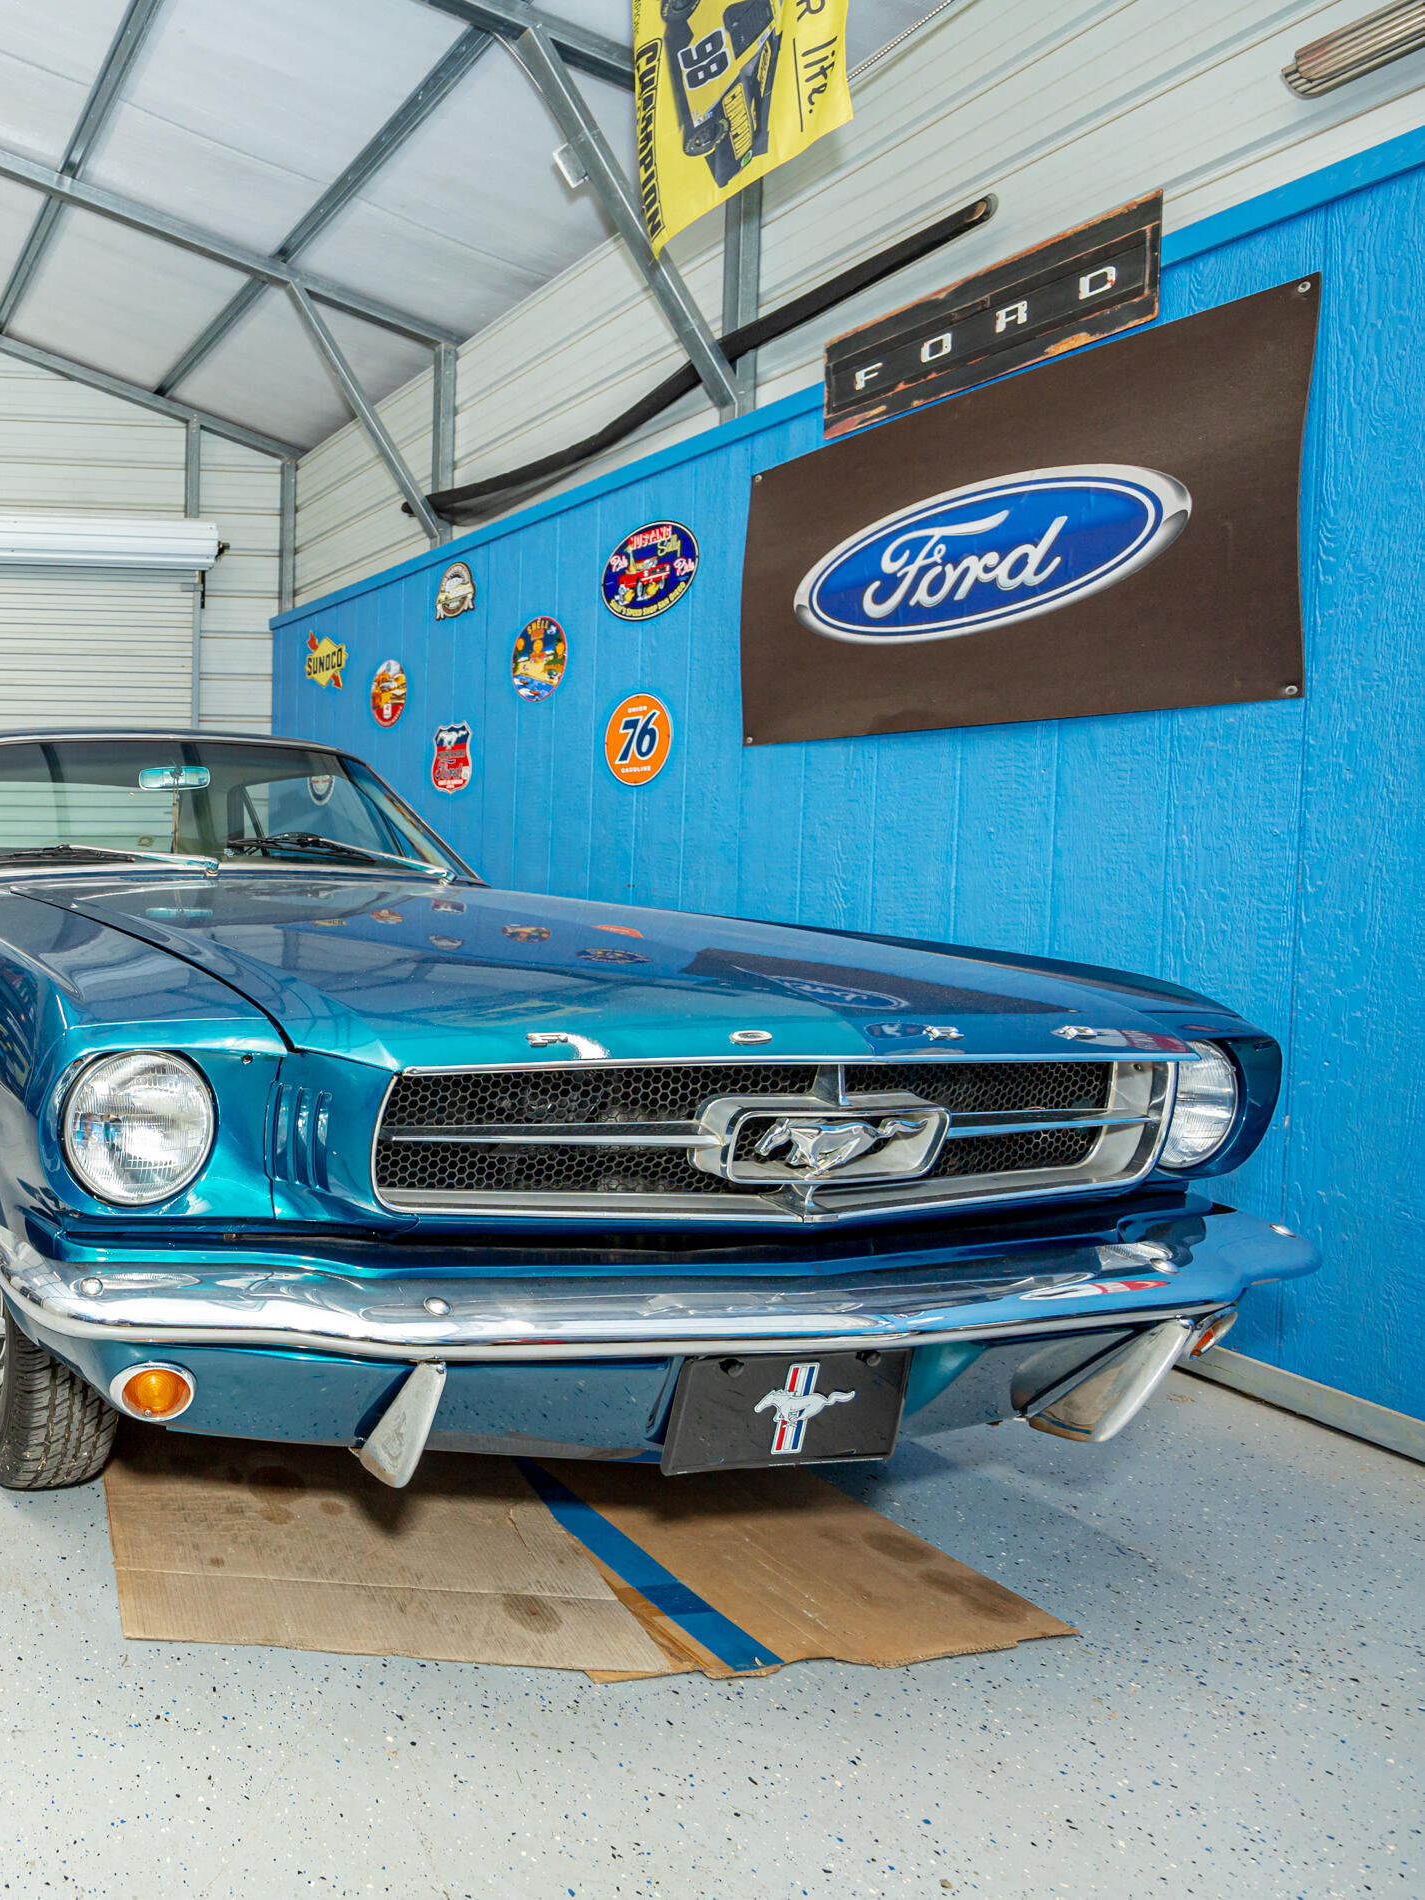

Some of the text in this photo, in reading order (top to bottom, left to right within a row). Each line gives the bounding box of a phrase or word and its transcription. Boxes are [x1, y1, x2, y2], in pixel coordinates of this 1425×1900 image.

[677, 28, 731, 90] 98
[801, 35, 838, 114] life.
[636, 39, 664, 241] CHAMPION
[722, 83, 753, 160] CHAMPION
[855, 265, 1116, 391] FORD
[627, 525, 672, 550] MUSTANG
[657, 533, 682, 558] Sally
[862, 508, 1068, 618] Ford
[642, 604, 658, 615] SHOP
[668, 581, 686, 602] DIEGO
[527, 619, 549, 635] SHELL
[306, 647, 343, 676] SUNOCO
[615, 709, 660, 764] 76
[620, 765, 652, 774] GASOLINE
[525, 1024, 1098, 1048] FORD
